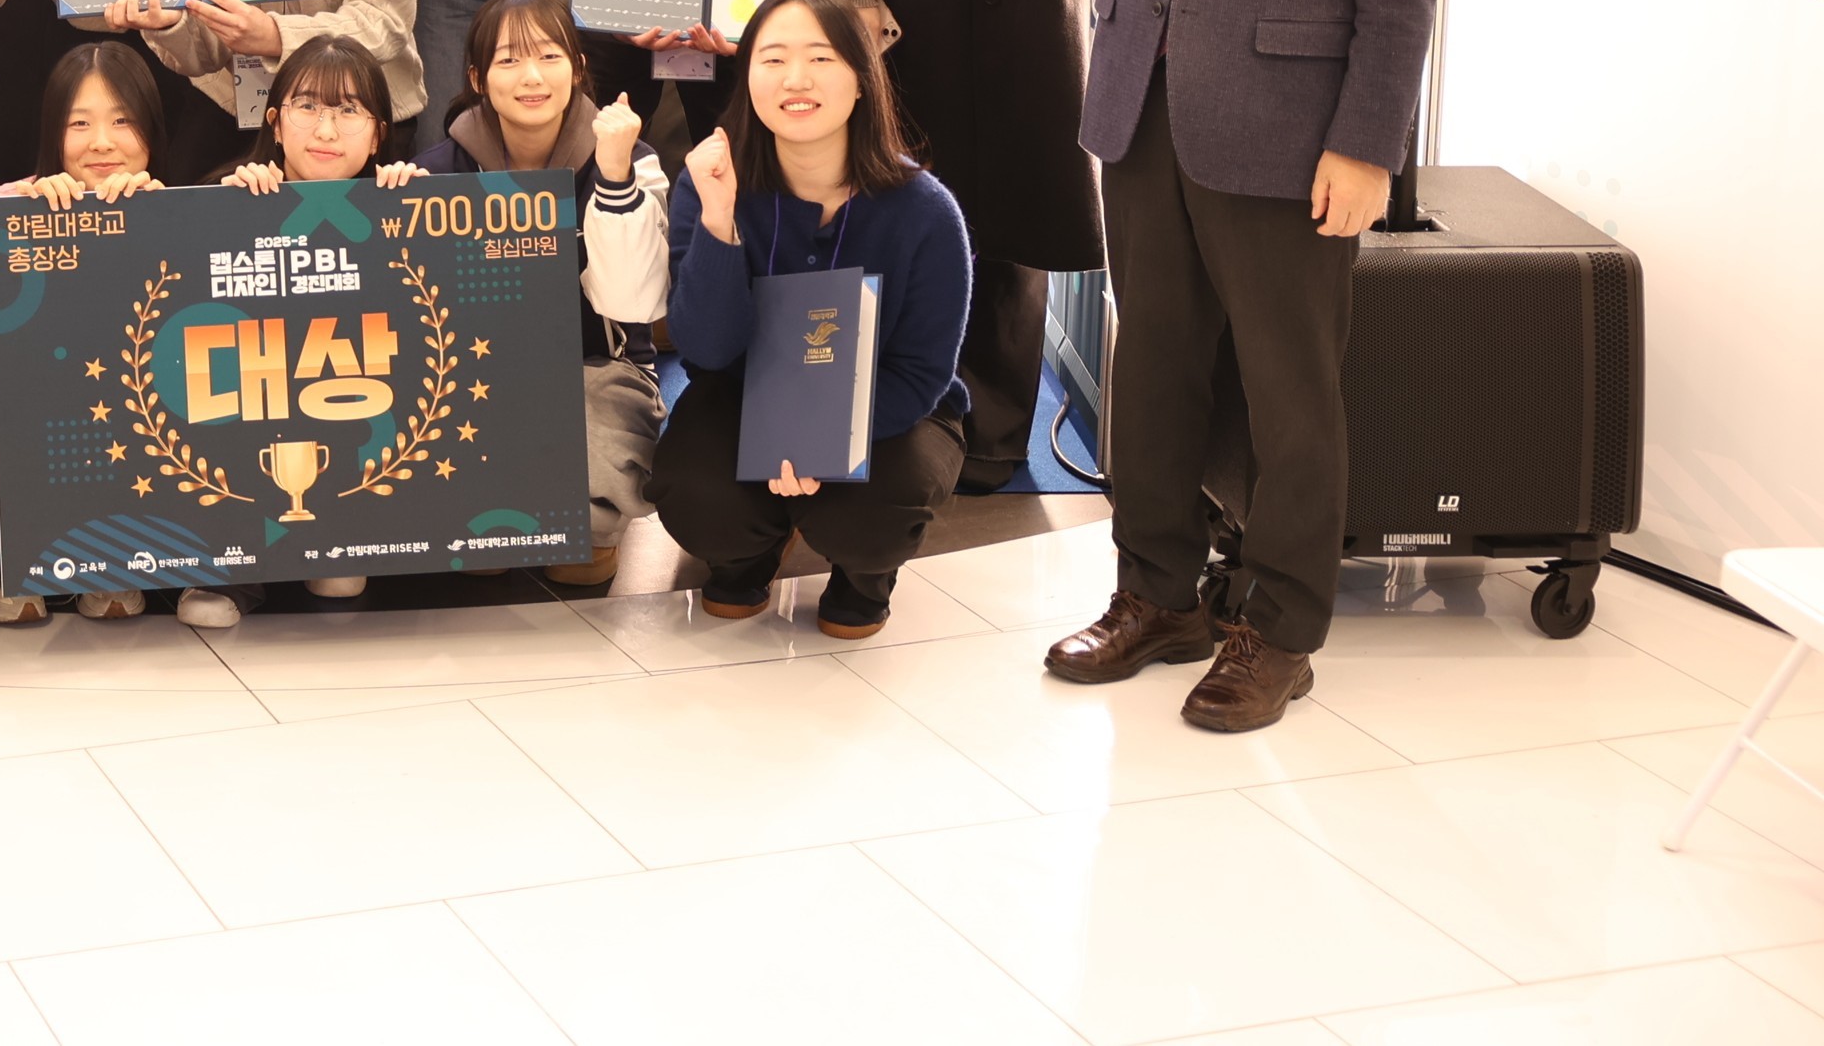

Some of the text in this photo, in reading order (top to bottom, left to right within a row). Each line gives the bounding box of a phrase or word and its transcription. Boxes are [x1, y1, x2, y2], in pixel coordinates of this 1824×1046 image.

[6, 210, 125, 239] 한림대학교
[381, 192, 558, 239] ₩700,000
[255, 236, 307, 249] 2025-2
[484, 237, 558, 260] 칠십만원
[7, 244, 80, 274] 총장상
[210, 251, 276, 274] 캡스톤
[291, 247, 358, 271] PBL
[211, 274, 277, 297] 디자인
[291, 273, 360, 294] 경진대회
[183, 312, 399, 424] 대상
[1438, 496, 1460, 507] LD
[305, 542, 429, 559] 주관 한림대학교 RISE본부
[468, 534, 566, 549] 한림대학교 RISE교육센터
[29, 563, 106, 576] 주최 교육부
[128, 557, 199, 570] NRF 한국연구재단
